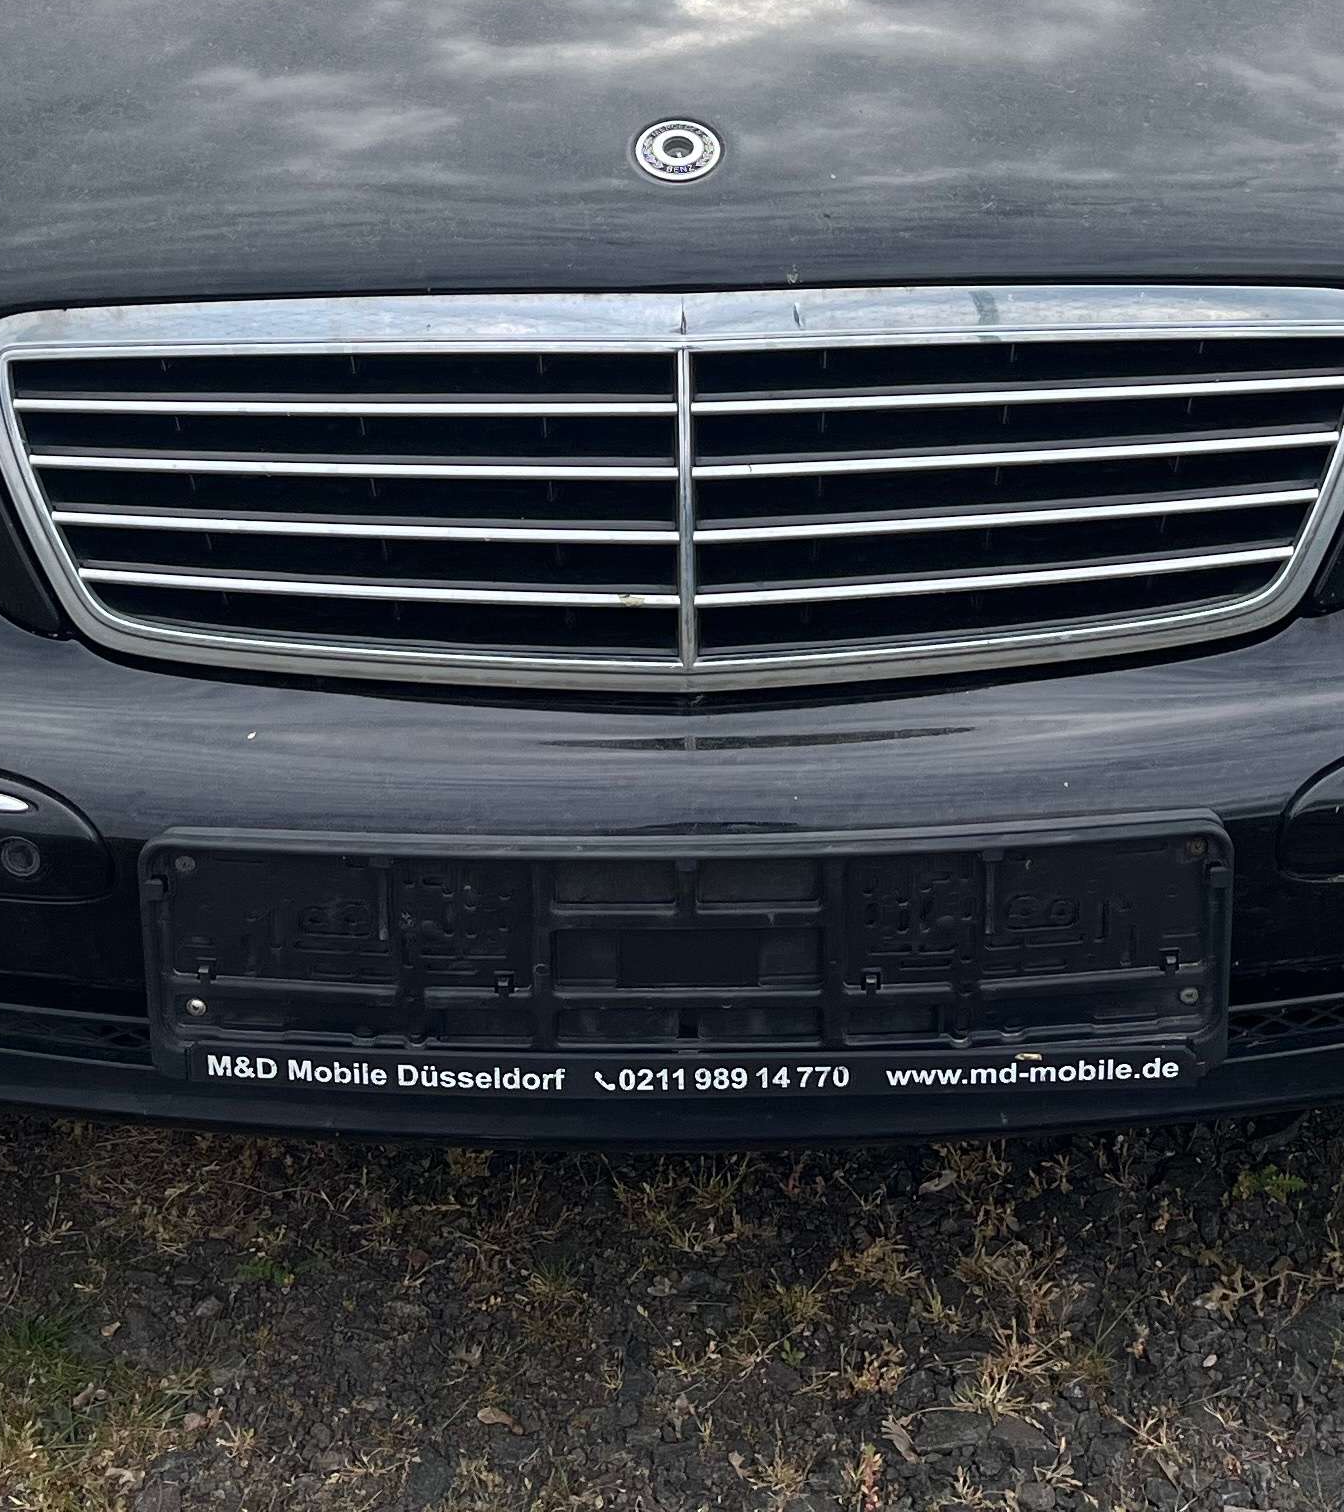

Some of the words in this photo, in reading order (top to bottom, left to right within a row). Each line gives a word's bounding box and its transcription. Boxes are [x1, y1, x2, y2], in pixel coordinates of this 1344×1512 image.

[207, 1054, 278, 1079] M&D
[287, 1059, 388, 1086] Mobile
[397, 1064, 566, 1090] Düsseldorf
[618, 1068, 685, 1091] 0211
[694, 1067, 748, 1090] 989
[755, 1066, 791, 1089] 14
[796, 1065, 850, 1088] 770
[885, 1057, 1179, 1086] www.md-mobile.de
